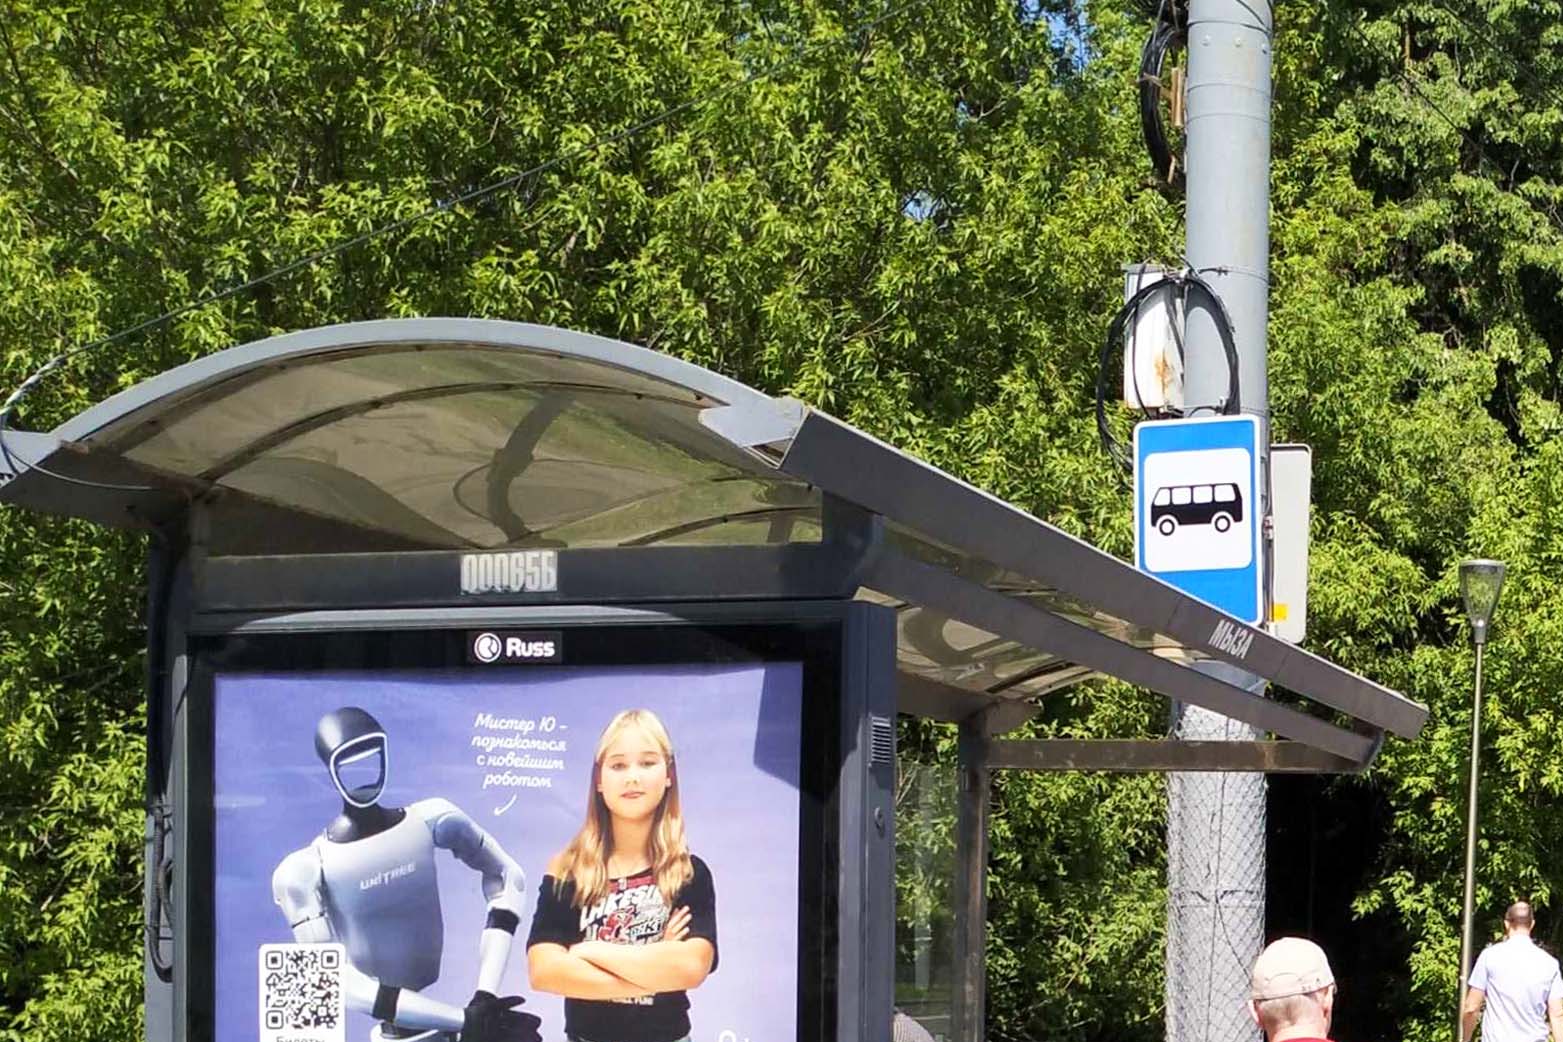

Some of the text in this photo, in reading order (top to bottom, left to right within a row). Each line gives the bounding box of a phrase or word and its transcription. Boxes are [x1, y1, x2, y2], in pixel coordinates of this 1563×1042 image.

[506, 637, 555, 657] Russ
[1207, 619, 1255, 660] МЫЗА
[474, 713, 535, 735] Мистер
[539, 716, 556, 732] Ю
[471, 733, 567, 752] познакомься
[476, 751, 564, 770] с новейшим
[482, 770, 552, 789] роботом
